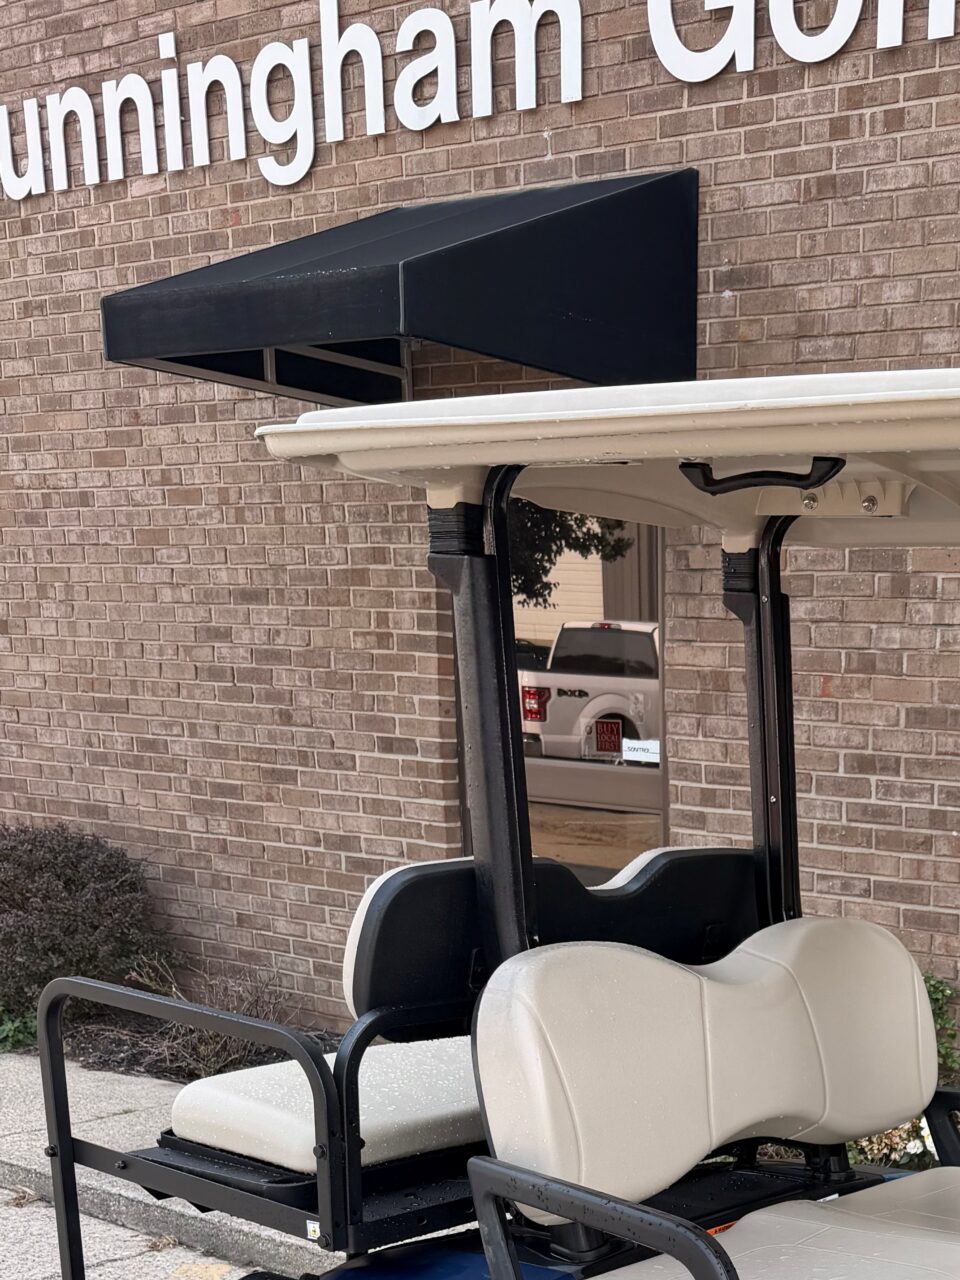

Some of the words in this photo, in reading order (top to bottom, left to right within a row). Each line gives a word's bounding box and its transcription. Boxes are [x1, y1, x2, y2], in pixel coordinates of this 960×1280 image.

[597, 722, 618, 735] BUY
[597, 734, 618, 742] LOCAL
[598, 742, 619, 750] FIRST
